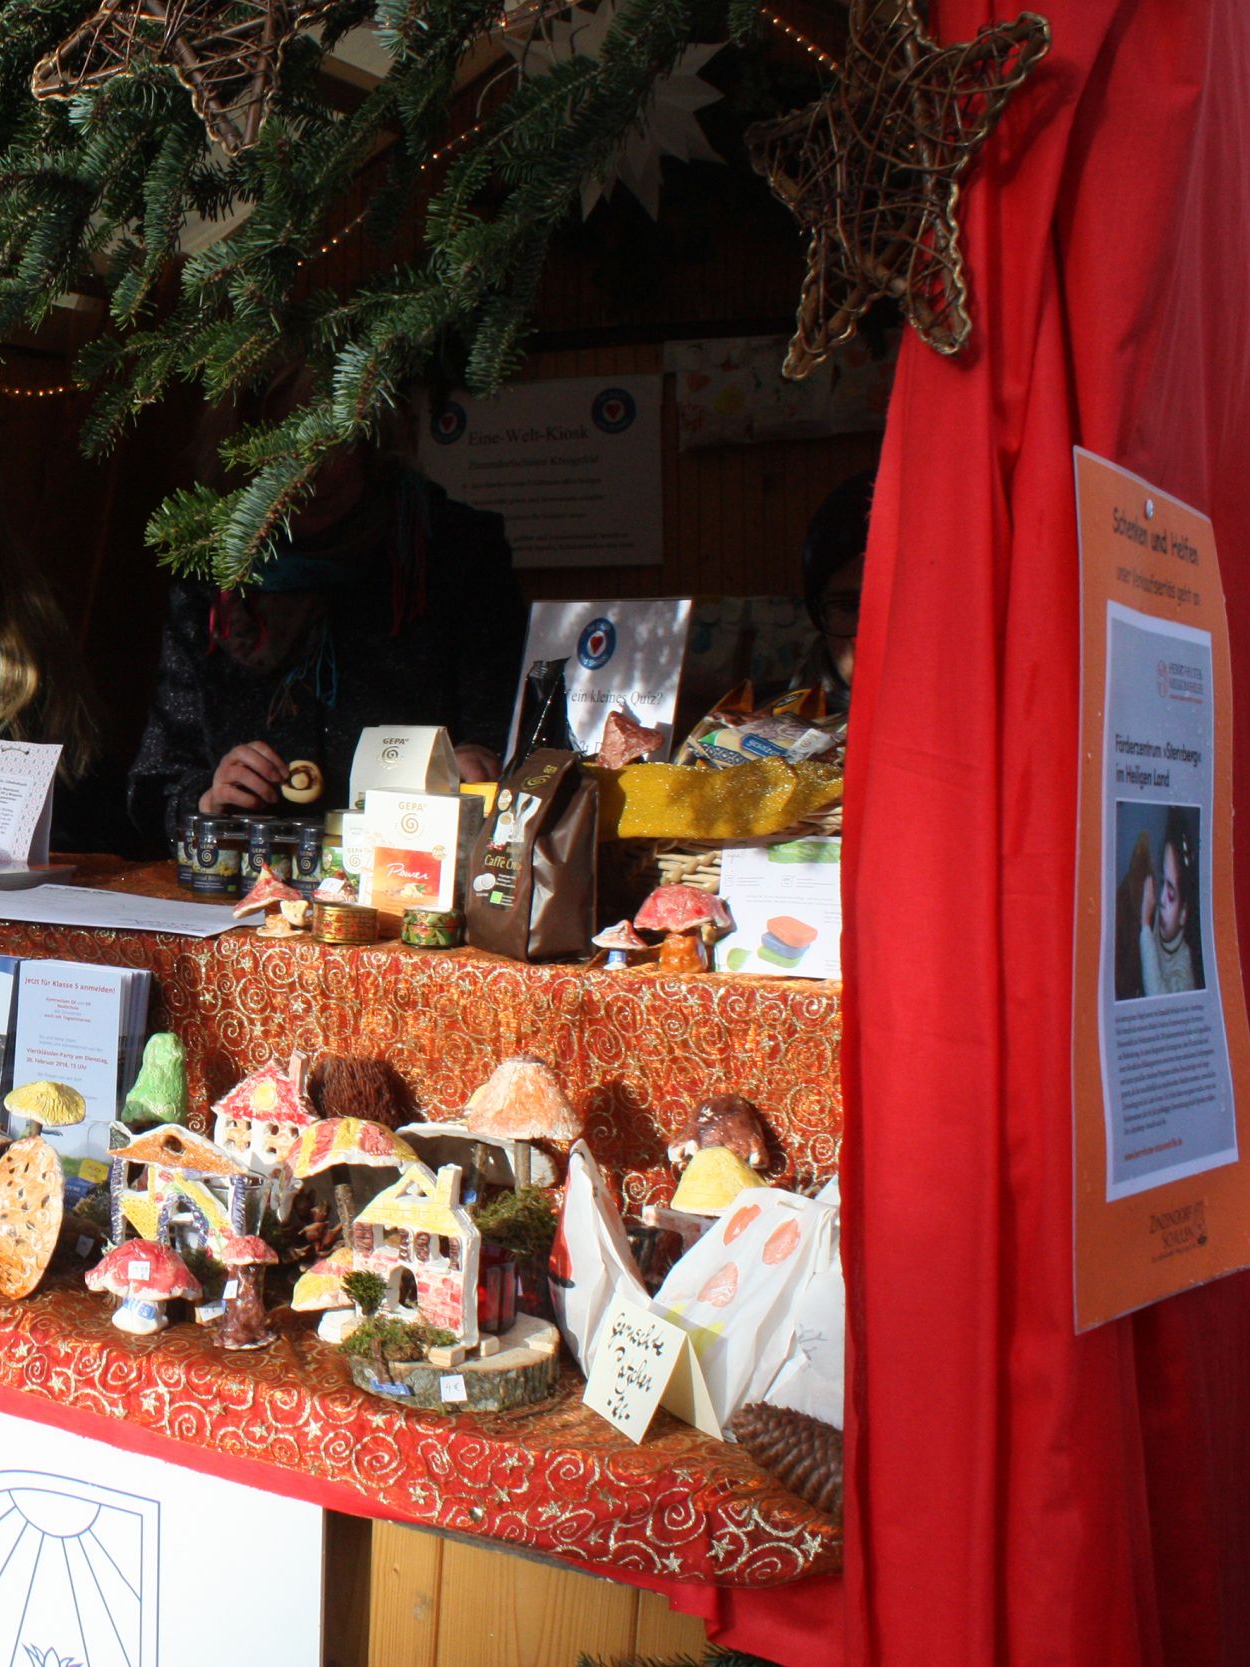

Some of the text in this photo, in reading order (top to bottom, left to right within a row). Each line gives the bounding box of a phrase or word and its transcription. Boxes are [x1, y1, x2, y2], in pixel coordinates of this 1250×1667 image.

[469, 425, 590, 446] Eine-Welt-Kiosk
[1150, 529, 1168, 555] und
[589, 687, 627, 706] kleines
[382, 737, 406, 746] GEPA
[1153, 768, 1170, 788] Land
[398, 801, 423, 812] GEPA
[24, 977, 40, 985] Jetzt
[41, 978, 51, 986] für
[52, 980, 73, 990] Klasse
[80, 985, 116, 994] anmelden!
